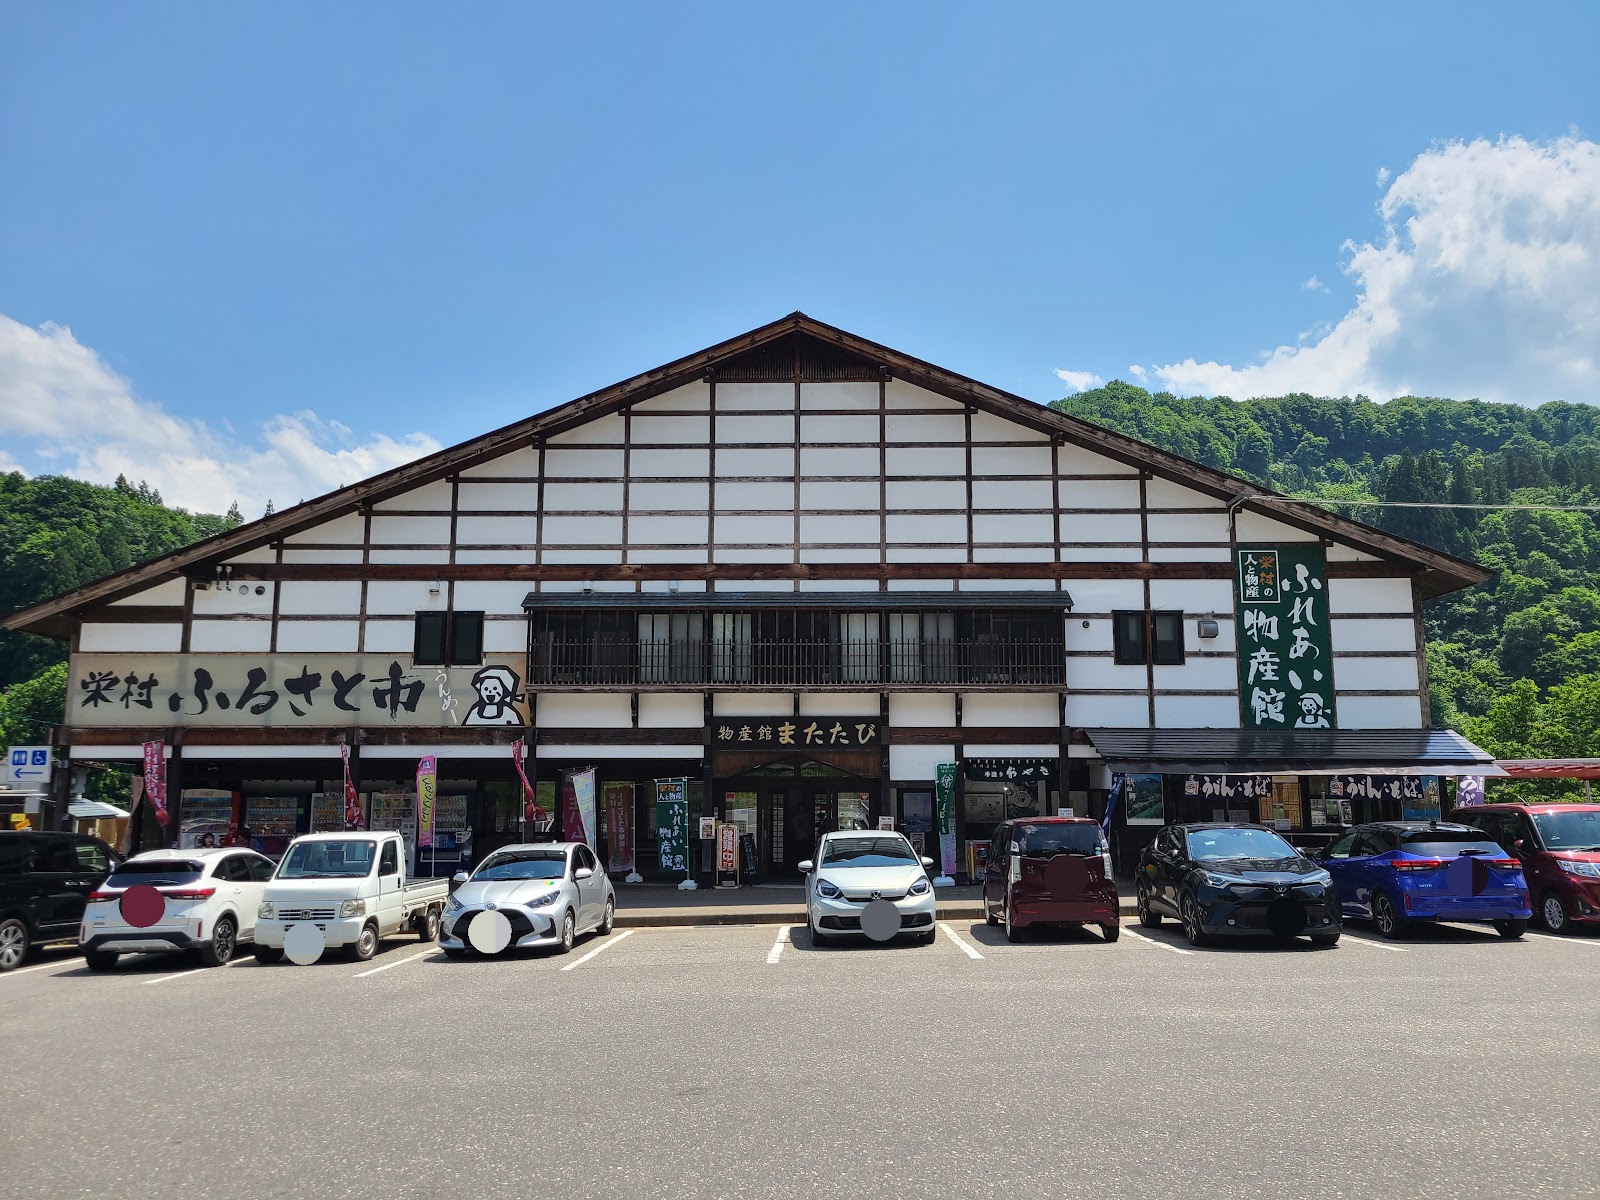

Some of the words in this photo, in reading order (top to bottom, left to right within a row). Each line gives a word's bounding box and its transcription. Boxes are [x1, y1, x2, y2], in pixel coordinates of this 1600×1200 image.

[1244, 554, 1260, 598] 人と物産
[1258, 555, 1275, 597] 栄村の
[1281, 563, 1324, 691] ふれあい
[1243, 608, 1286, 726] 物産館
[1459, 775, 1477, 807] うど
[669, 803, 684, 847] ふれあい
[659, 827, 674, 868] 物産館
